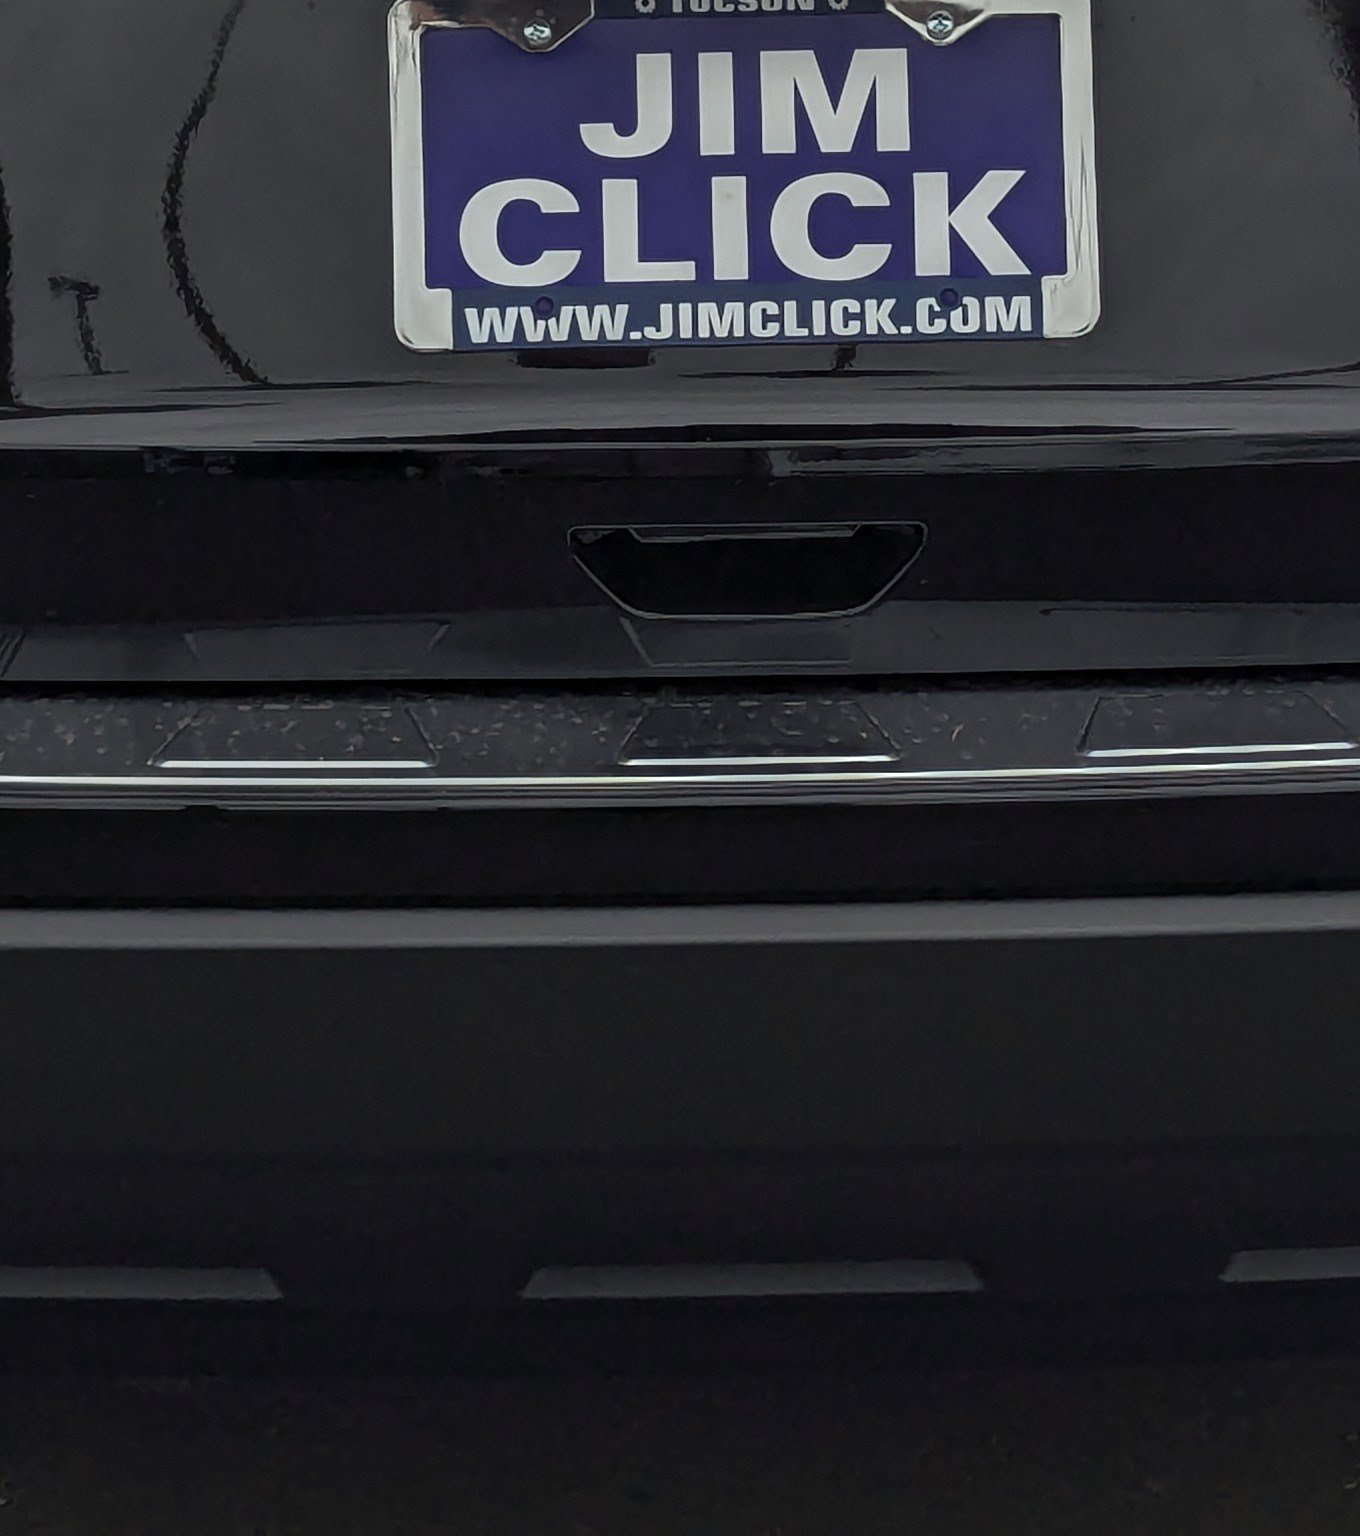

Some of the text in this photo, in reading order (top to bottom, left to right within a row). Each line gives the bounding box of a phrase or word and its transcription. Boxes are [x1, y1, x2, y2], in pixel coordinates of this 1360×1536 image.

[578, 47, 912, 159] JIM
[458, 169, 1033, 288] CLICK
[463, 294, 1033, 344] WWW.JIMCLICK.COM
